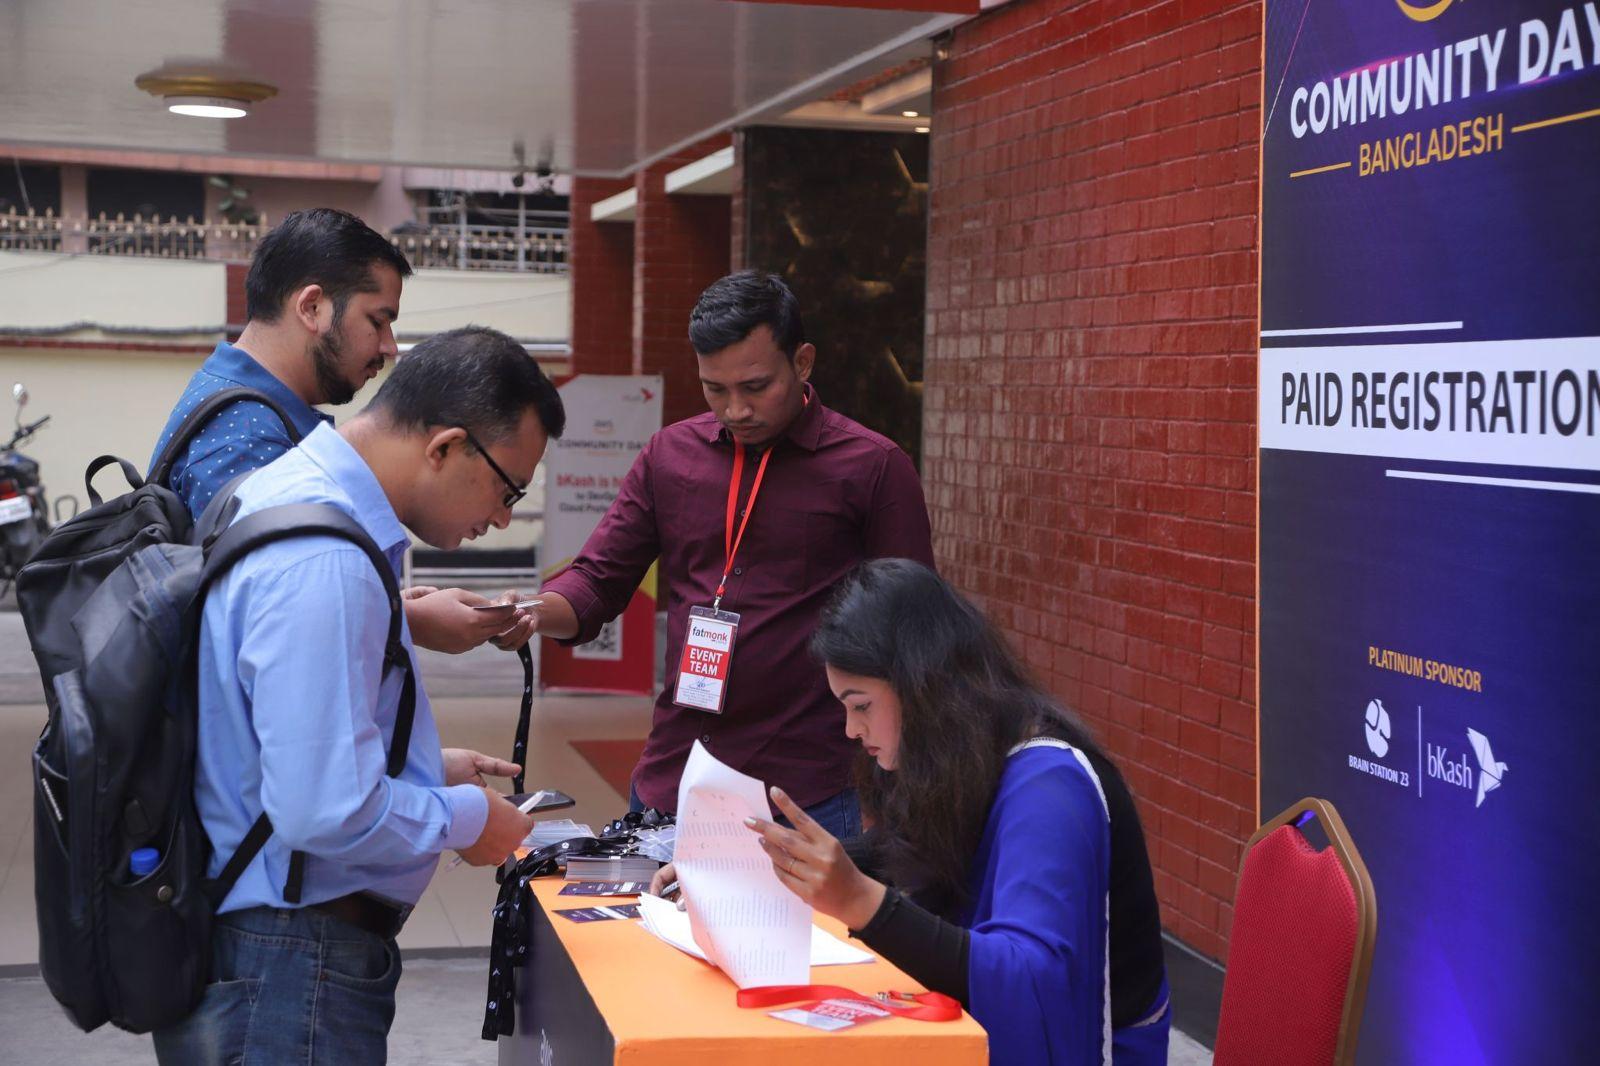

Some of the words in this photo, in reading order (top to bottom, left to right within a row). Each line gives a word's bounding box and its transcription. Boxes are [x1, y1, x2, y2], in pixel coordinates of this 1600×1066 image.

[1290, 28, 1507, 139] COMMUNITY
[1359, 113, 1503, 178] BANGLADESH
[1281, 371, 1343, 428] PAID
[690, 648, 723, 664] EVENT
[692, 626, 728, 641] fatmonk
[690, 660, 718, 676] TEAM
[1369, 646, 1423, 678] PLATINUM
[1425, 660, 1482, 693] SPONSOR
[1349, 754, 1369, 773] BRAIN
[1369, 762, 1398, 783] STATION
[1400, 771, 1409, 787] 23
[1428, 742, 1472, 789] bKash
